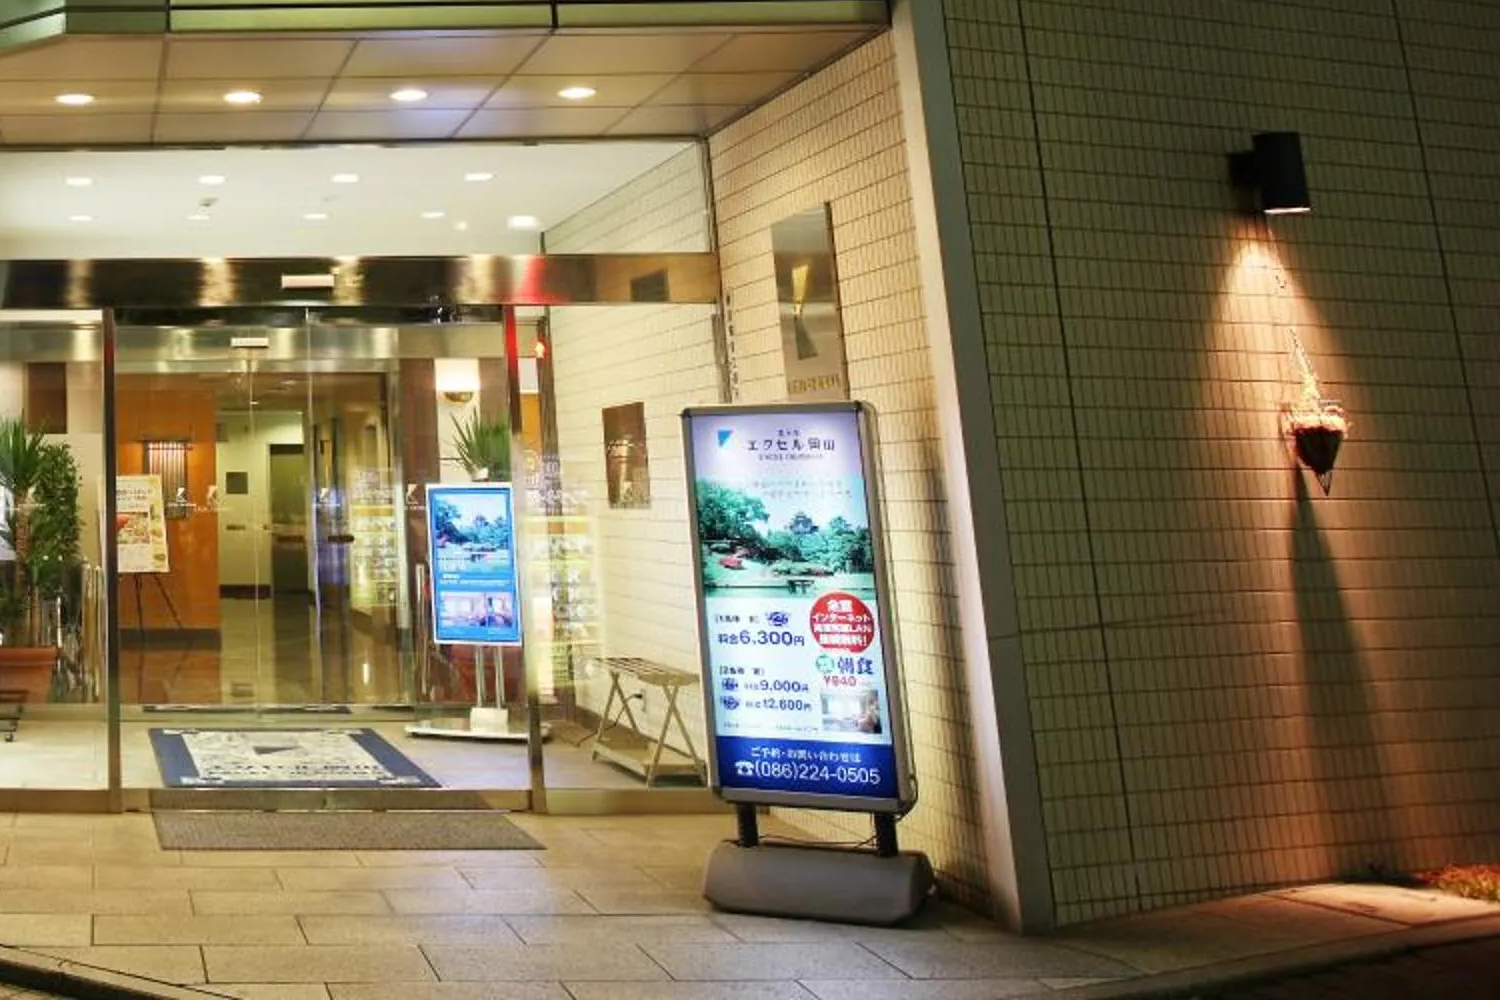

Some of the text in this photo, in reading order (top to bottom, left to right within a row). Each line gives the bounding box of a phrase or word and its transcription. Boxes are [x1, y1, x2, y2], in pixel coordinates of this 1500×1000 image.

[747, 437, 836, 451] エクセル岡山
